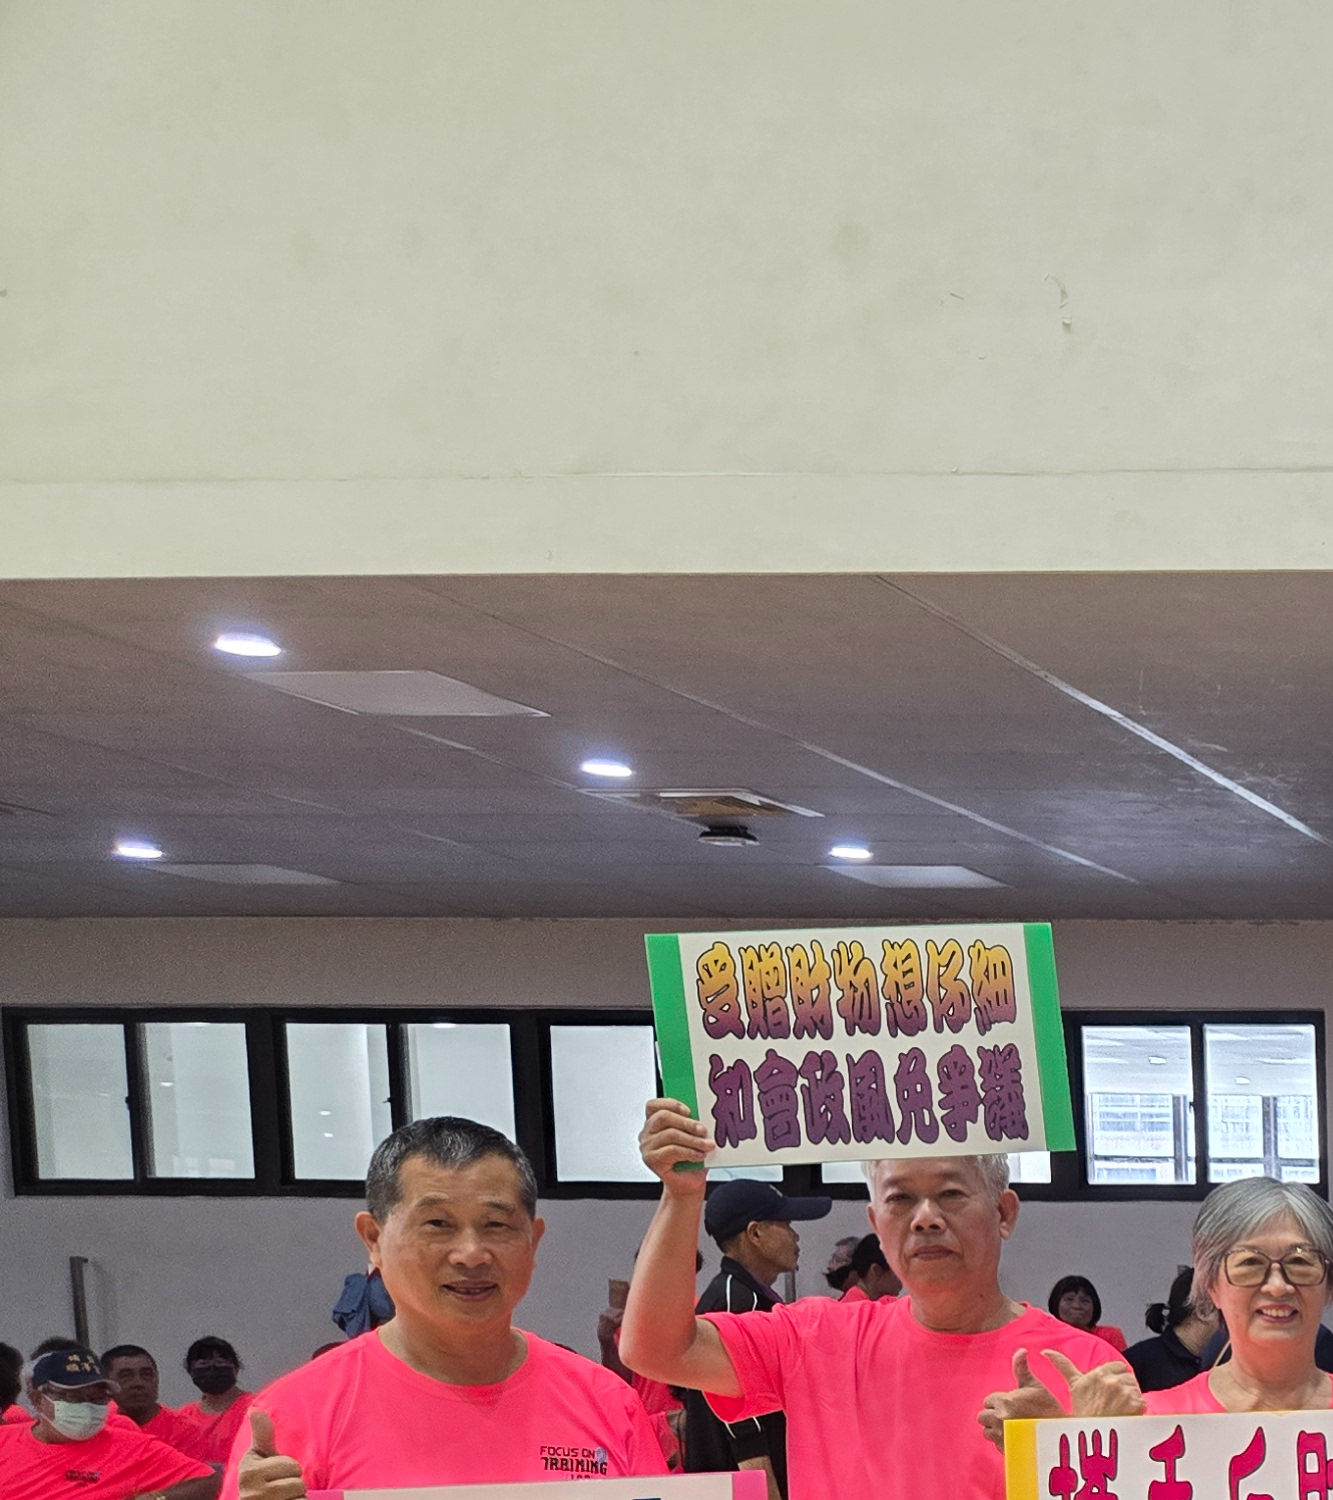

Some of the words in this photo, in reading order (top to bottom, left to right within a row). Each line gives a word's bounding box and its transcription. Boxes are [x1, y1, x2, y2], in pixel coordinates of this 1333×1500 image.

[696, 938, 1017, 1040] 受贈財物想仔細
[708, 1042, 1030, 1152] 知會政風免爭議
[540, 1445, 580, 1458] FOCUS
[581, 1447, 596, 1460] ON
